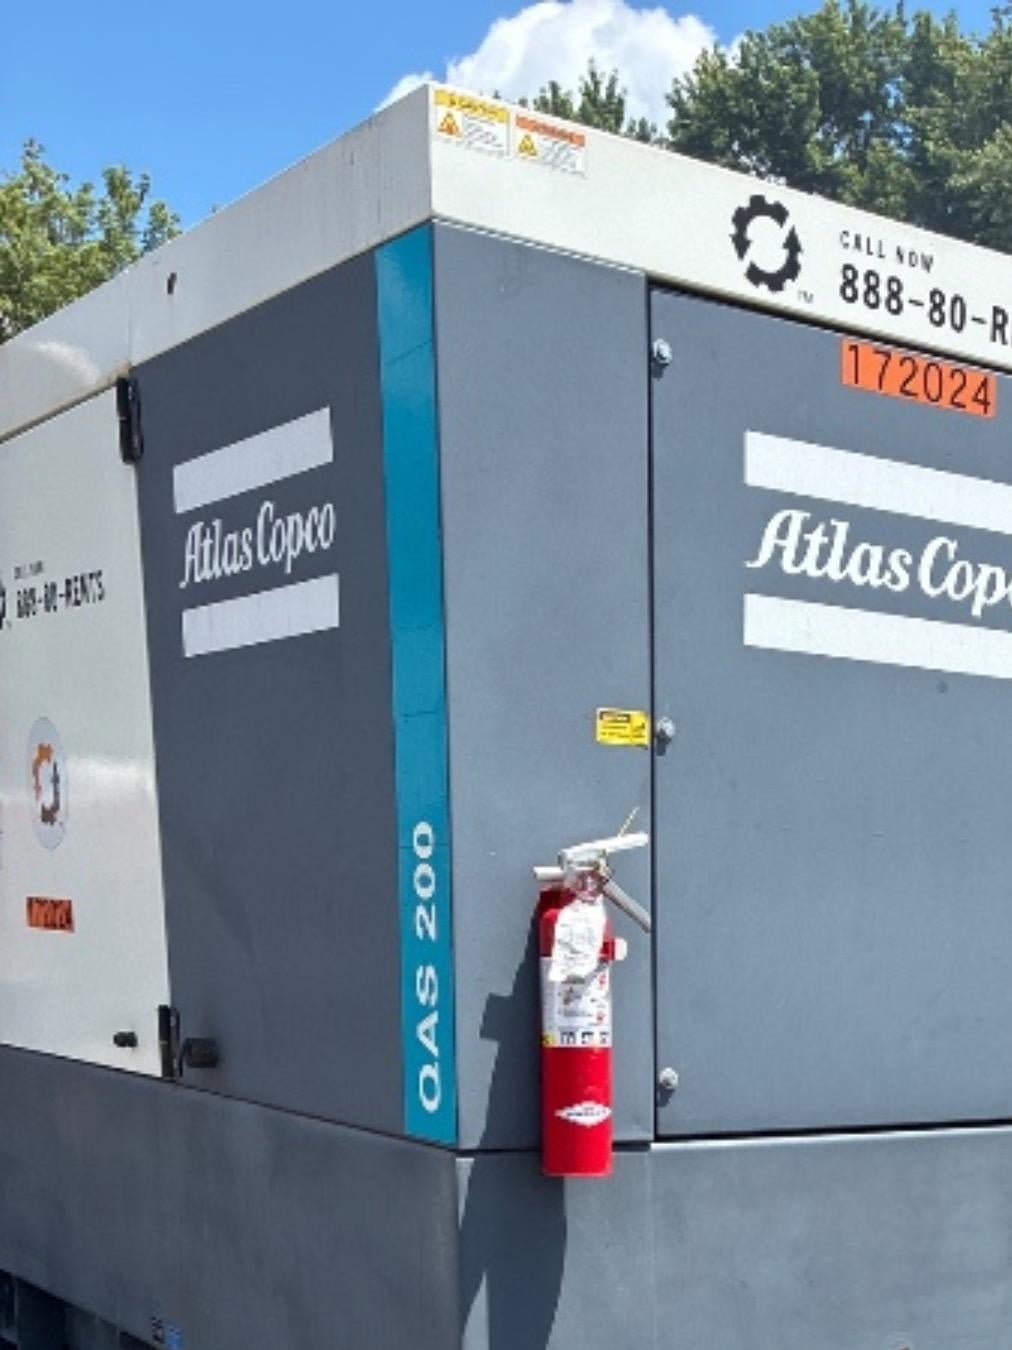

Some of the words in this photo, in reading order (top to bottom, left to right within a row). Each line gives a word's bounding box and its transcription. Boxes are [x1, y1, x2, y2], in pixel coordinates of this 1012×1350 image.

[839, 230, 887, 259] CALL
[896, 245, 935, 273] NOW
[847, 344, 992, 415] 172024
[177, 517, 253, 589] Atlas
[256, 500, 336, 575] Copco
[745, 508, 914, 593] Atlas
[413, 821, 437, 941] 200
[416, 964, 442, 1113] QAS
